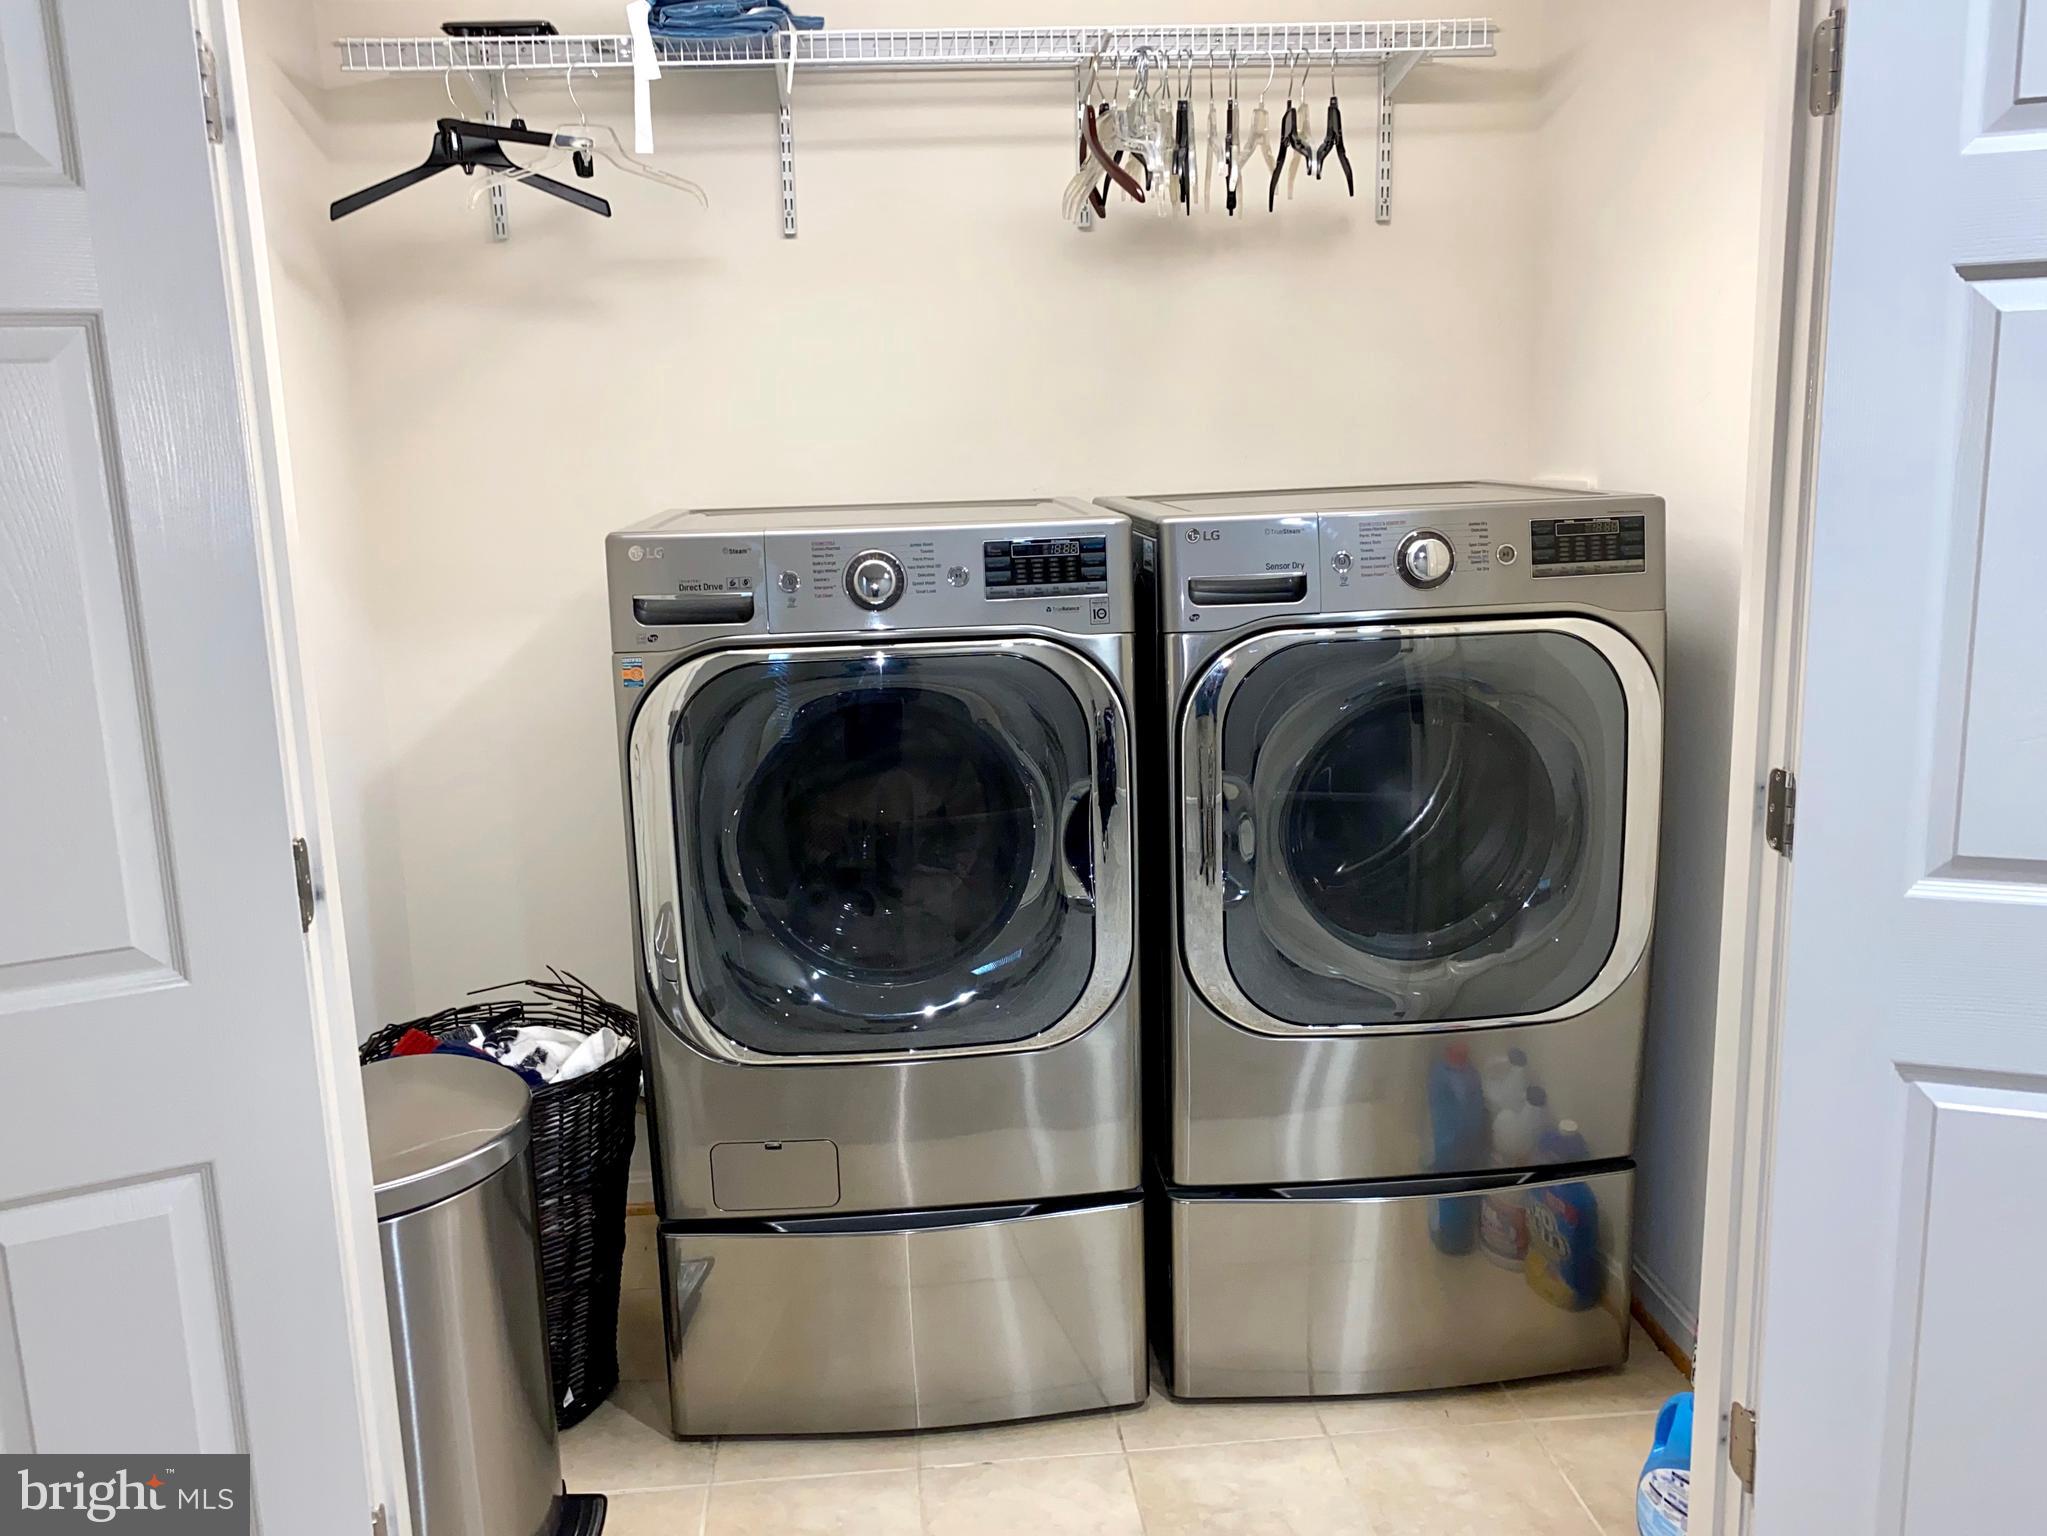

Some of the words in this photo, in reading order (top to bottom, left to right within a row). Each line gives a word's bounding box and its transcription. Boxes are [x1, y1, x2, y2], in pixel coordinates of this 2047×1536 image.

[1203, 530, 1221, 541] LG
[646, 547, 665, 559] LG
[1265, 562, 1290, 571] Sensor
[1292, 561, 1305, 571] Dry
[679, 583, 702, 592] Direct
[703, 582, 723, 591] Drive
